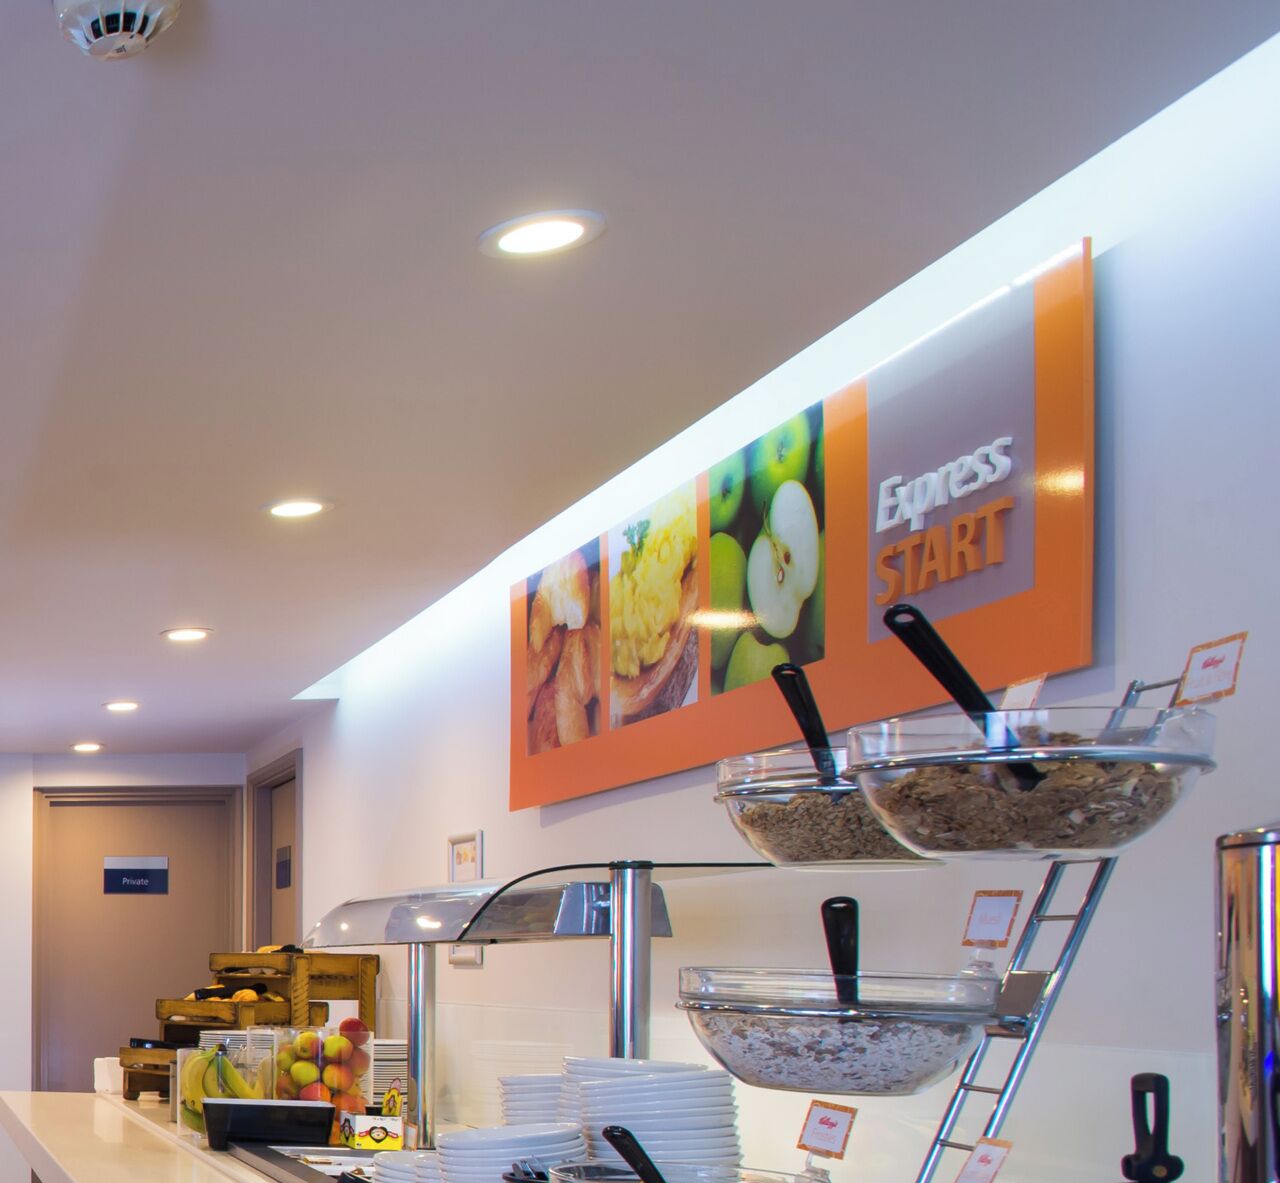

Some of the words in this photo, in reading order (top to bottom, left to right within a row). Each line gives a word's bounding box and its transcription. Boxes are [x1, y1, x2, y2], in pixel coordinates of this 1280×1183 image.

[875, 436, 1013, 533] Express
[874, 496, 1014, 605] START
[122, 877, 149, 886] Private
